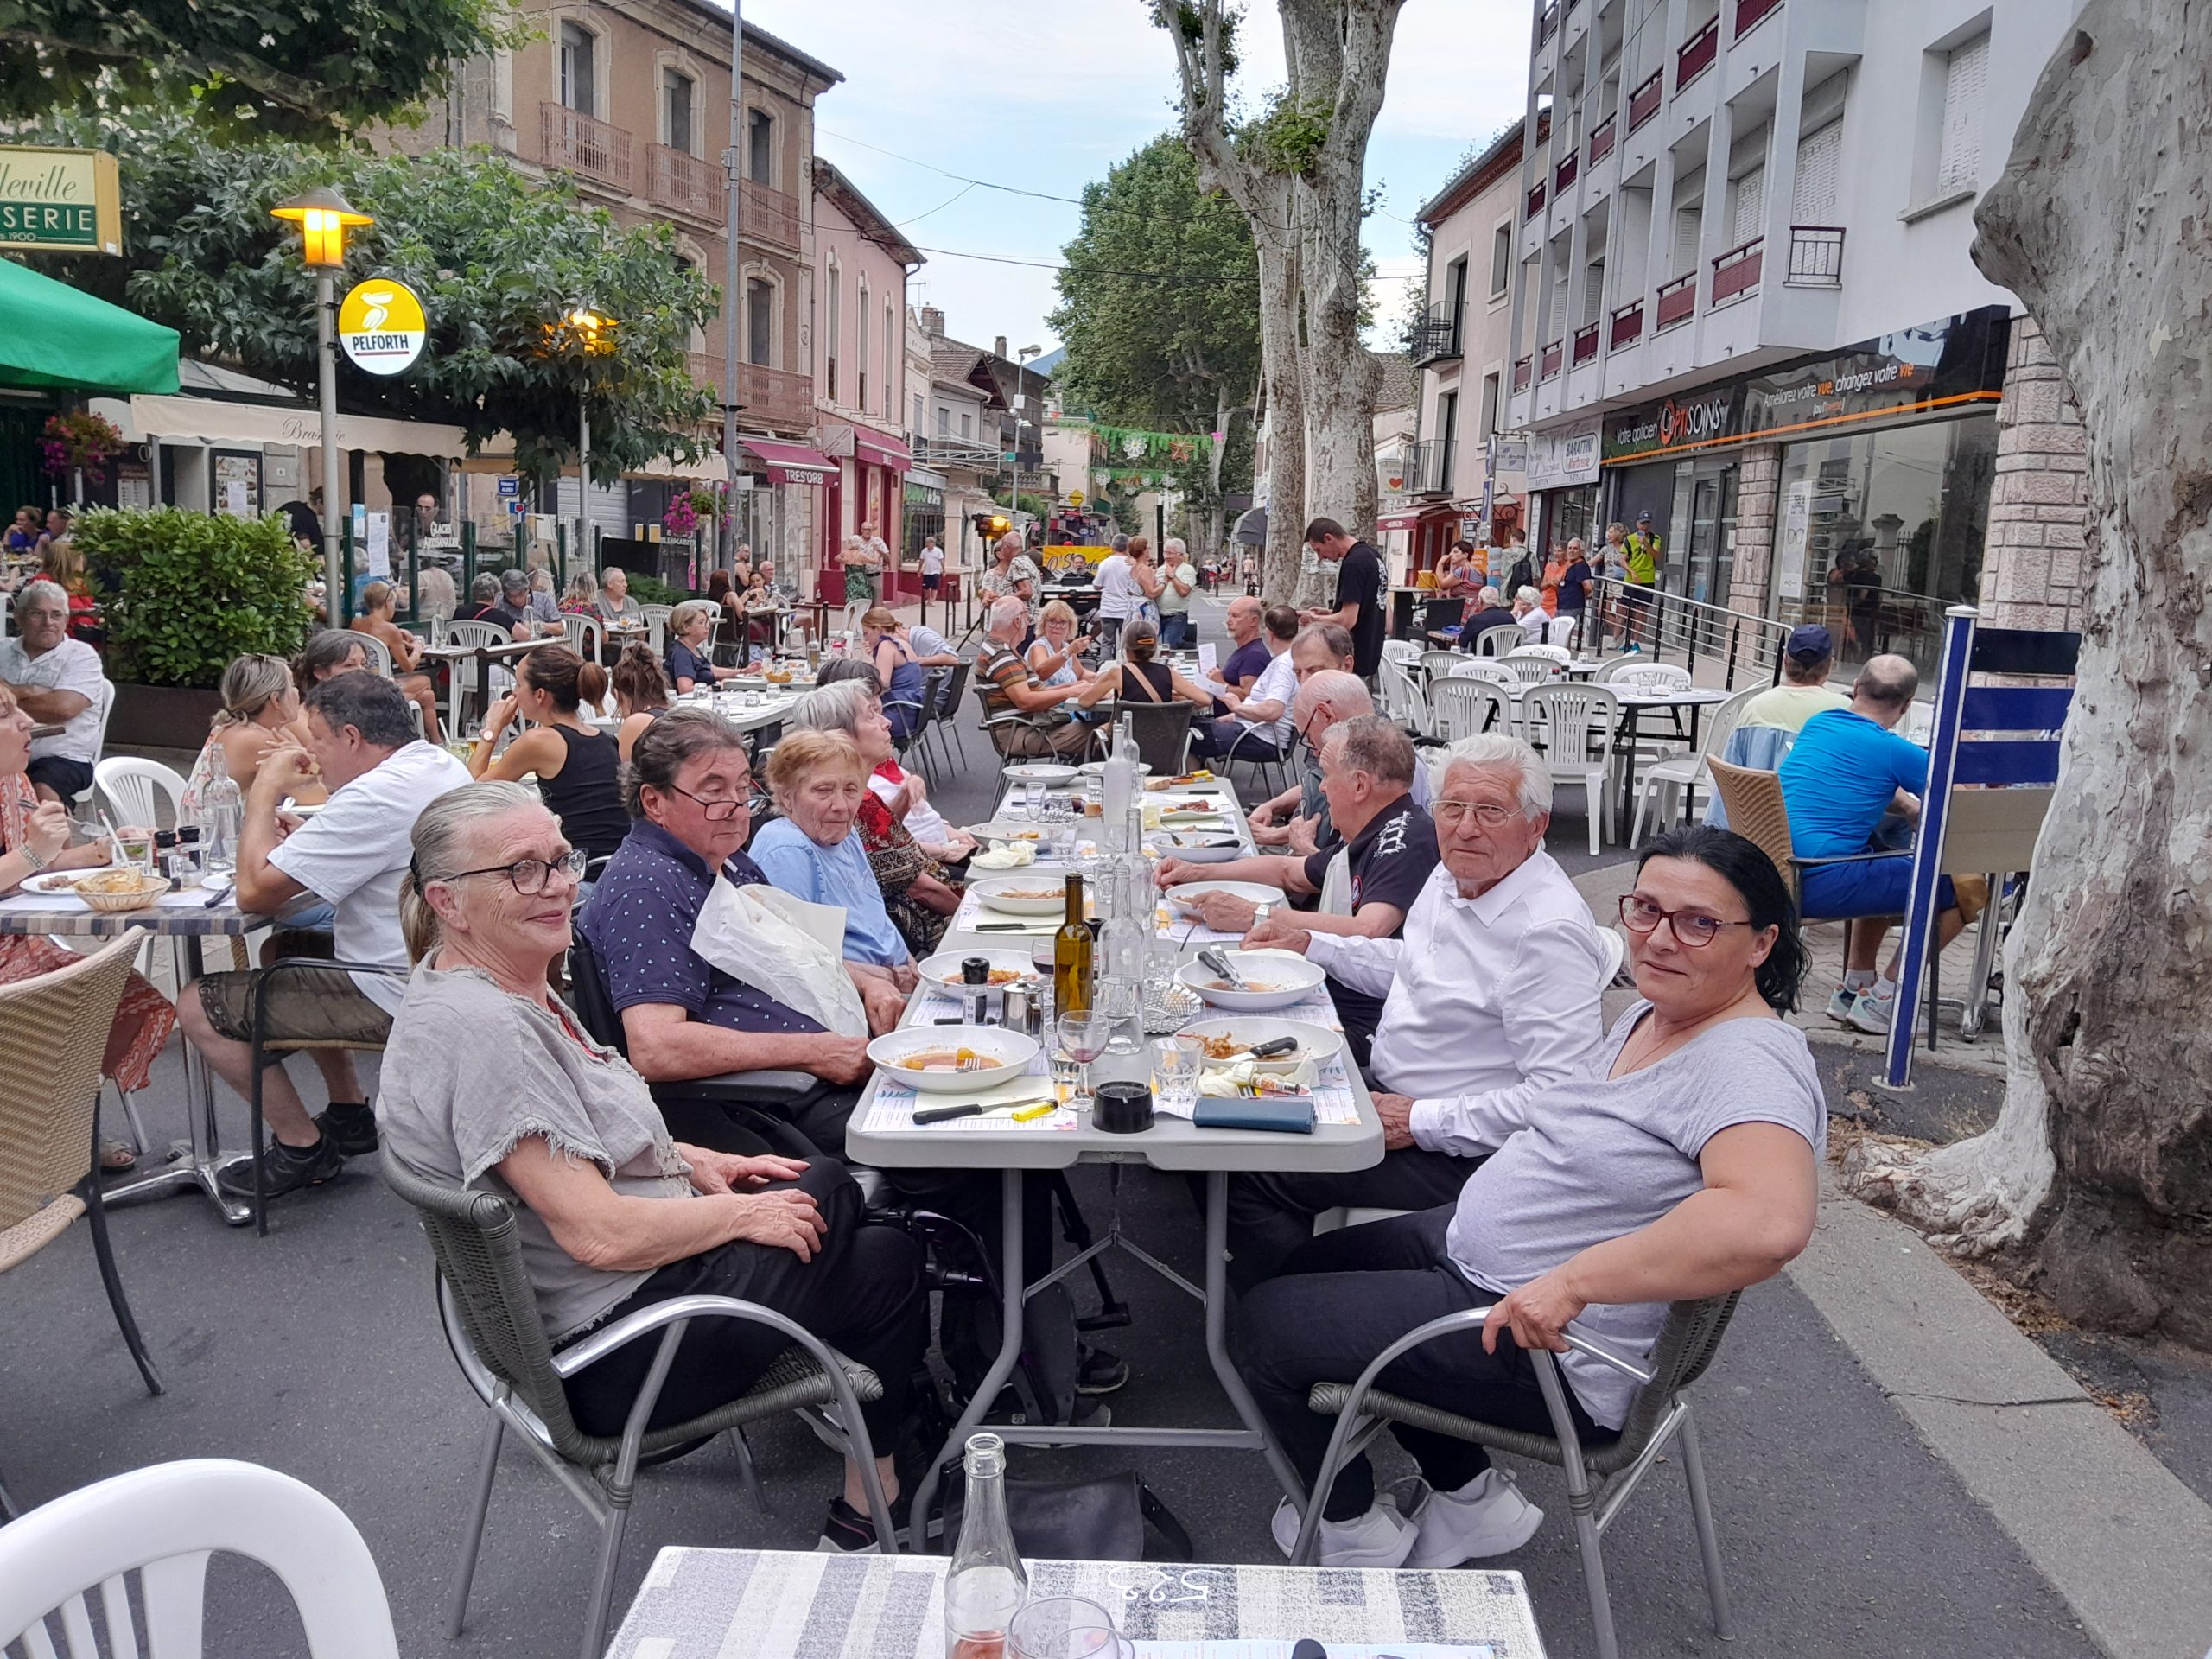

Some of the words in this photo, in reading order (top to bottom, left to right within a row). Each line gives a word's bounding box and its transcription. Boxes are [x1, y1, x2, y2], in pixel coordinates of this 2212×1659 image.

[3, 206, 92, 231] SERIE
[9, 231, 35, 241] 1900
[352, 334, 409, 350] PELFORTH
[1763, 387, 1797, 409] Améliorez
[1797, 382, 1817, 399] votre
[1835, 372, 1873, 392] changez
[1874, 363, 1898, 384] votre
[1899, 362, 1915, 378] vie
[1617, 427, 1632, 446] Votre
[1632, 420, 1658, 446] opticien
[785, 469, 823, 484] TRES'ORB
[1107, 1566, 1224, 1603] 523
